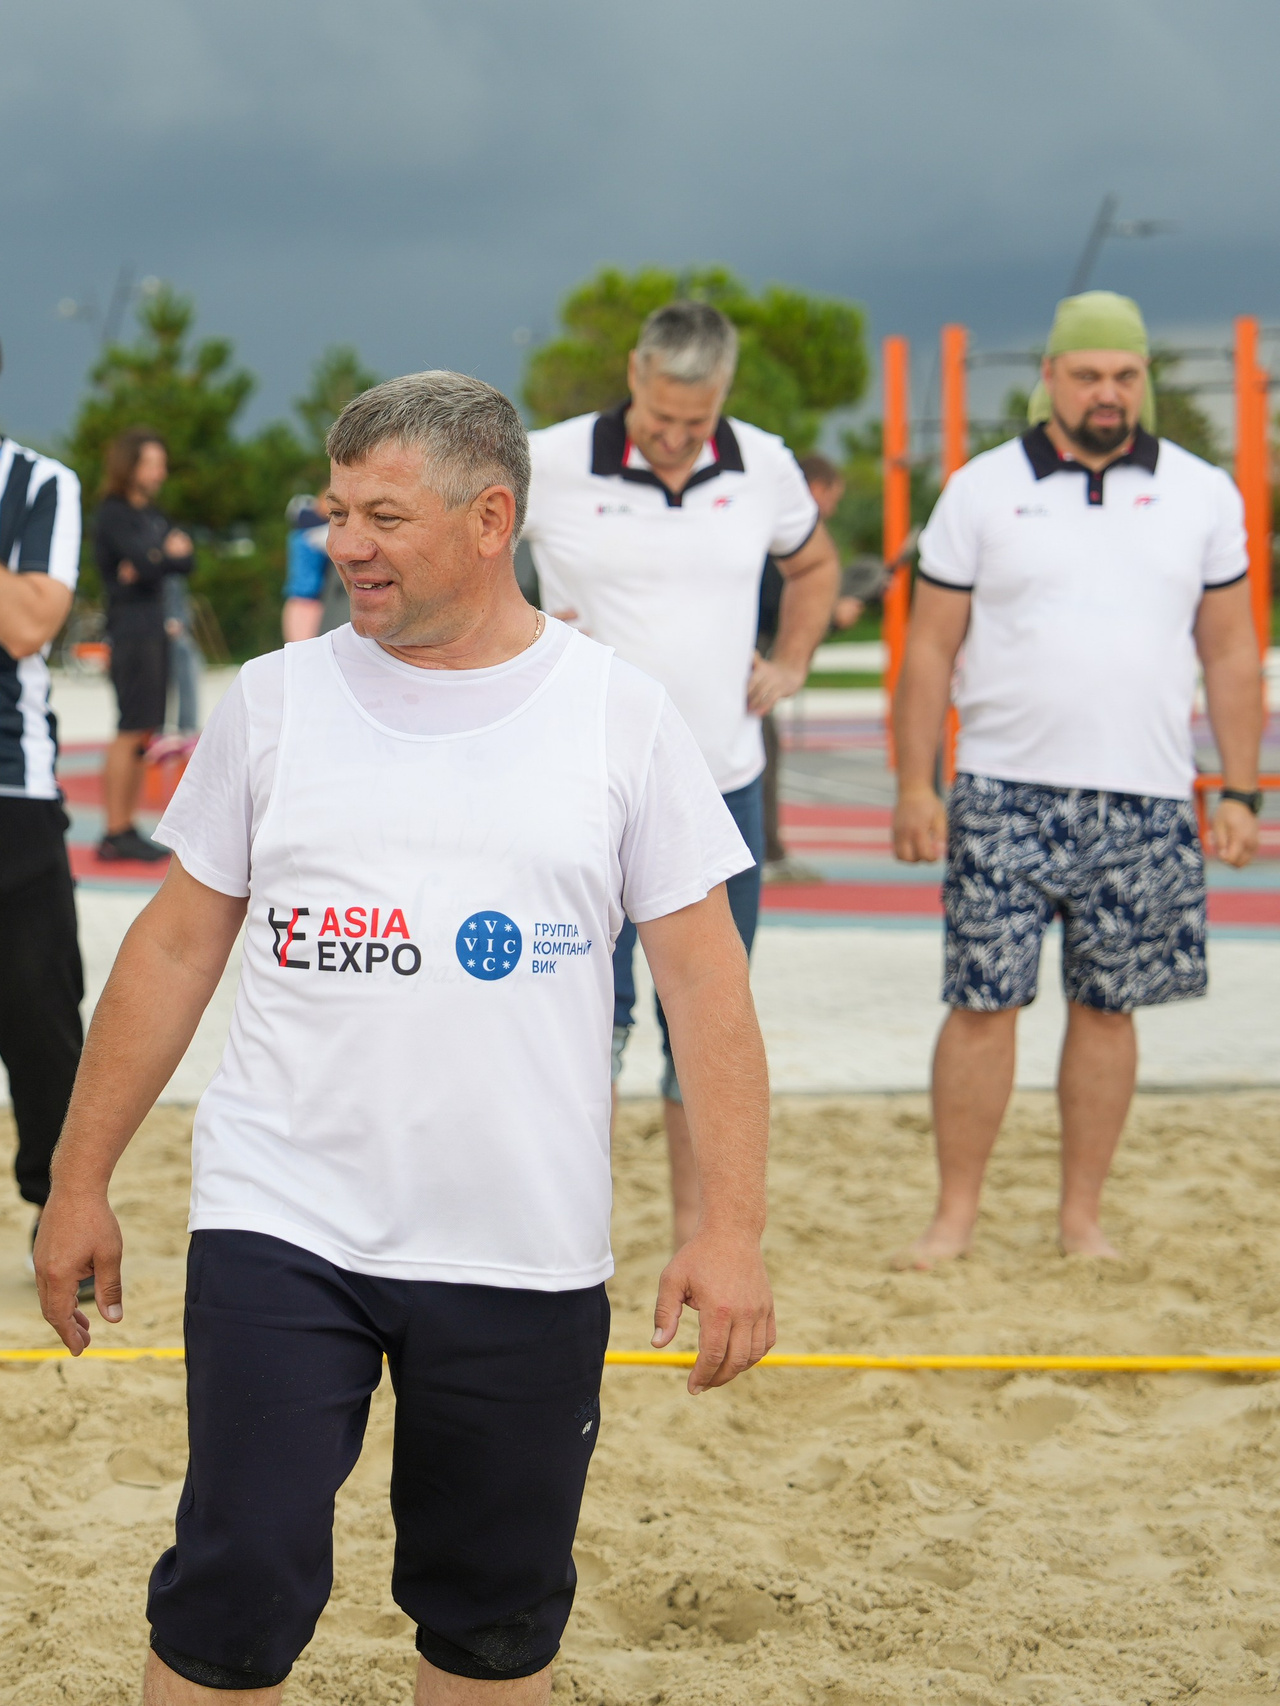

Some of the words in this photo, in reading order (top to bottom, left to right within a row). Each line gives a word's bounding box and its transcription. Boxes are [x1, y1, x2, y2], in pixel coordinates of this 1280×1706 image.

[318, 907, 410, 940] ASIA
[534, 923, 579, 938] ГРУППА
[317, 940, 422, 976] EXPO
[532, 960, 558, 974] ВИК
